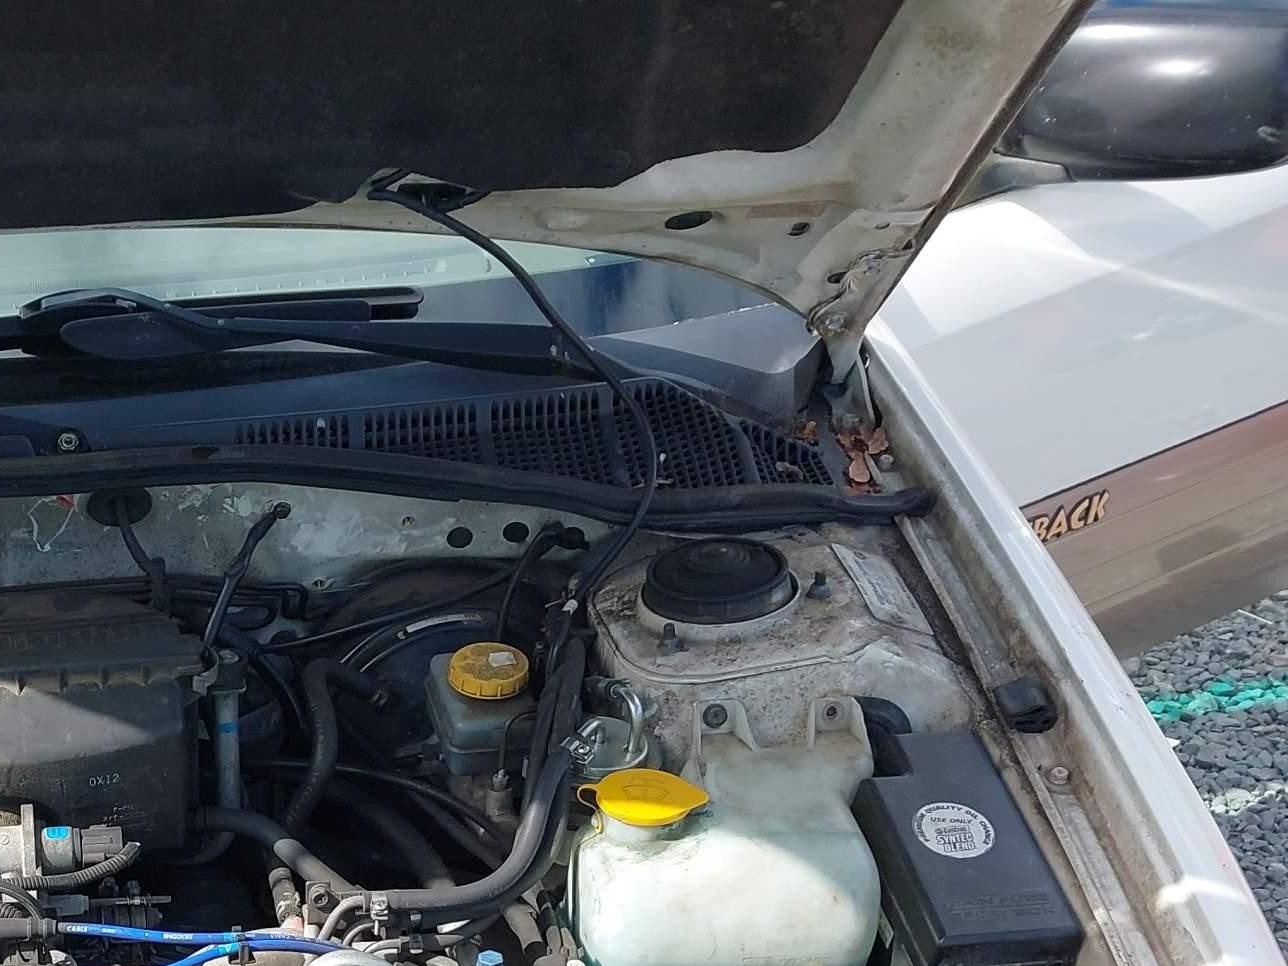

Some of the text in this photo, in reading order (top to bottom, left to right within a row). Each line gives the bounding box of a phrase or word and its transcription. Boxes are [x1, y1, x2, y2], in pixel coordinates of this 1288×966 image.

[1027, 488, 1110, 542] BACK
[925, 805, 963, 814] QUALITY
[949, 817, 973, 825] ONLY
[944, 842, 976, 852] BLEND
